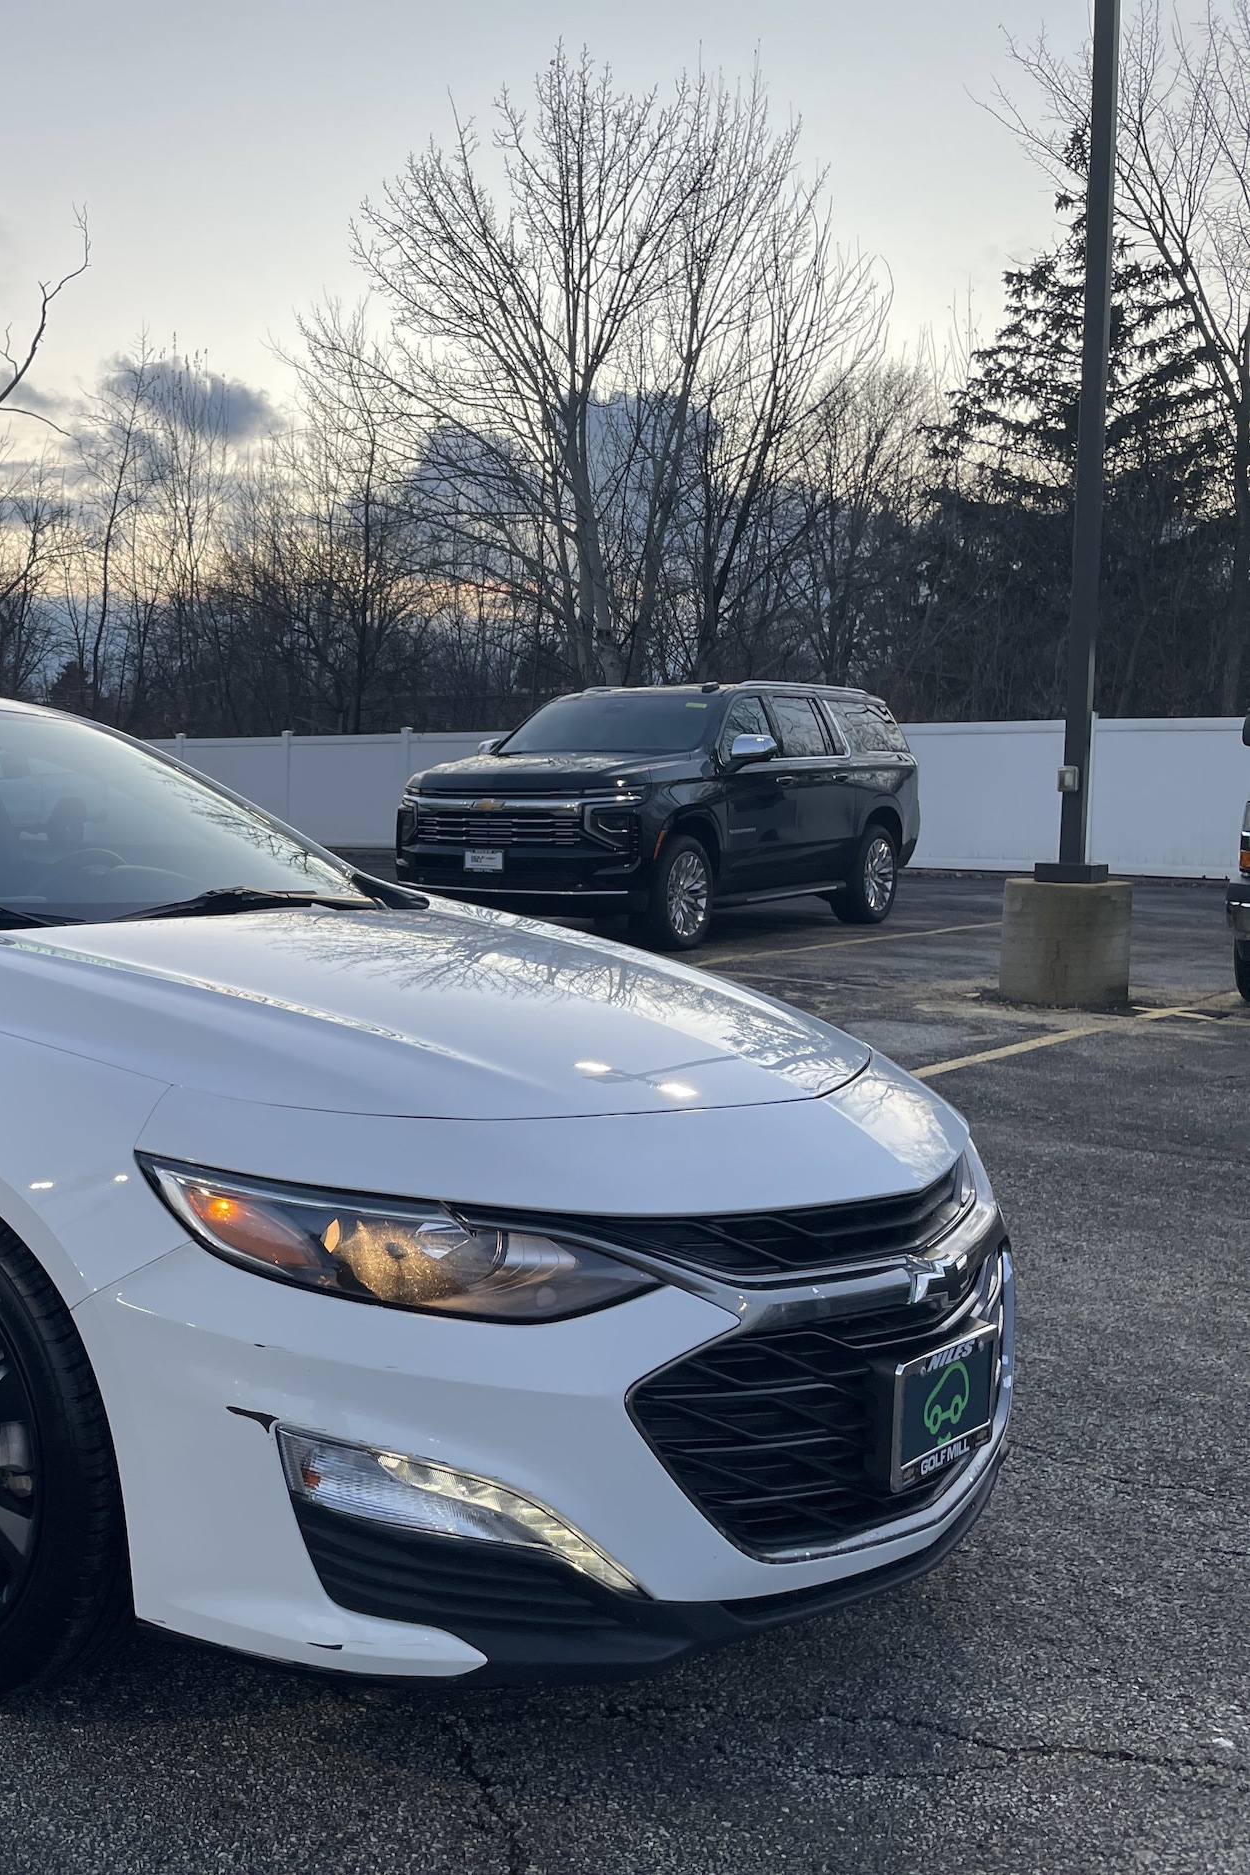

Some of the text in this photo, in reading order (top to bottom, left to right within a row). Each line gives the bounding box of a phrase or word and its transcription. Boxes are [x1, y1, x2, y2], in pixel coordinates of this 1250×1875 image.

[927, 1339, 976, 1373] NILES
[920, 1439, 971, 1476] GOLF MILL
